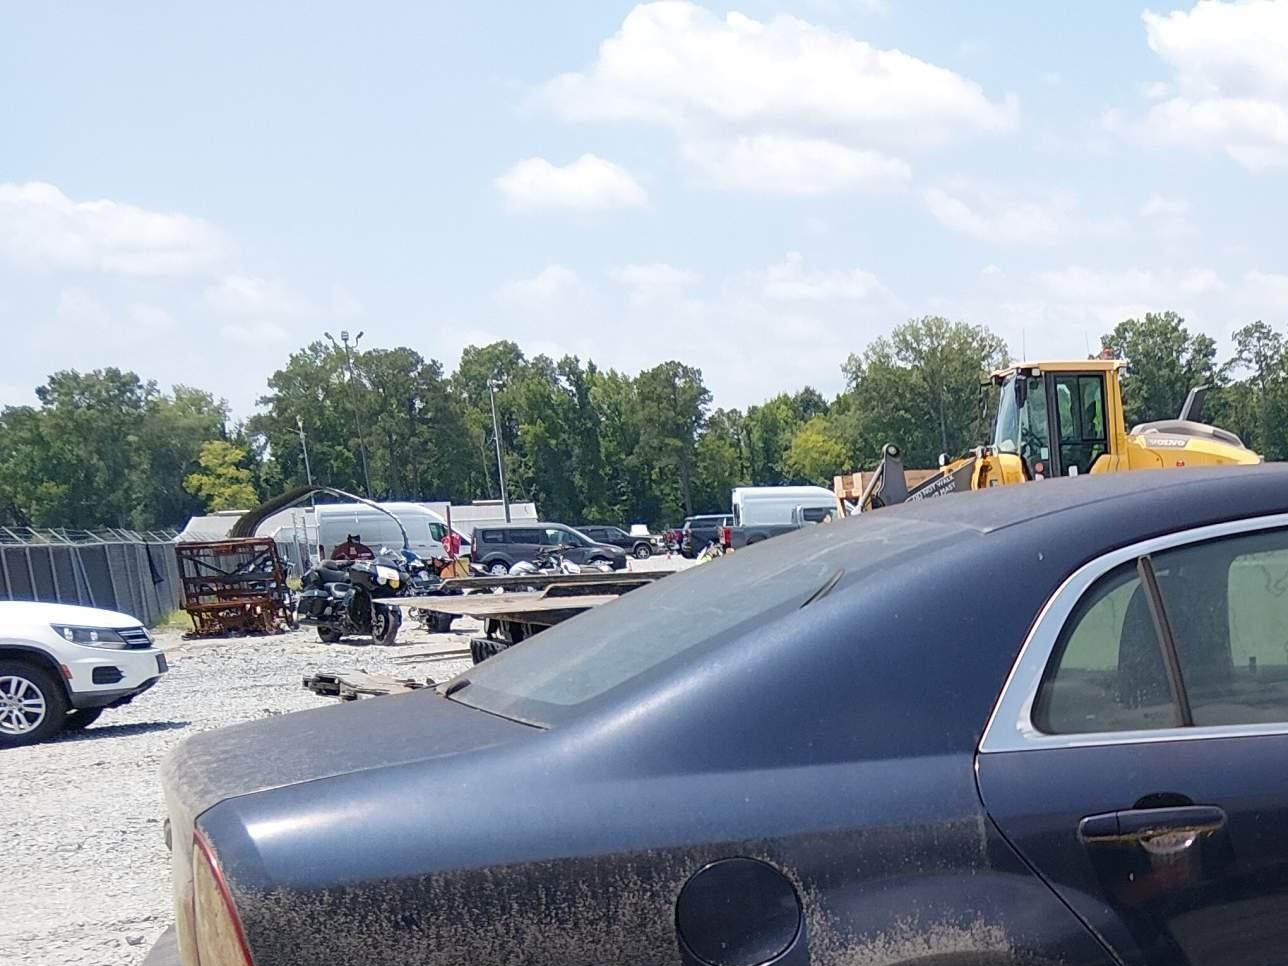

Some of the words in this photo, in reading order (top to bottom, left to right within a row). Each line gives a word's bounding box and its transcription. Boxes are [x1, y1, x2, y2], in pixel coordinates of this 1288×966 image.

[1149, 439, 1186, 447] VOLVO
[923, 483, 936, 495] NOT
[937, 475, 955, 487] WALK
